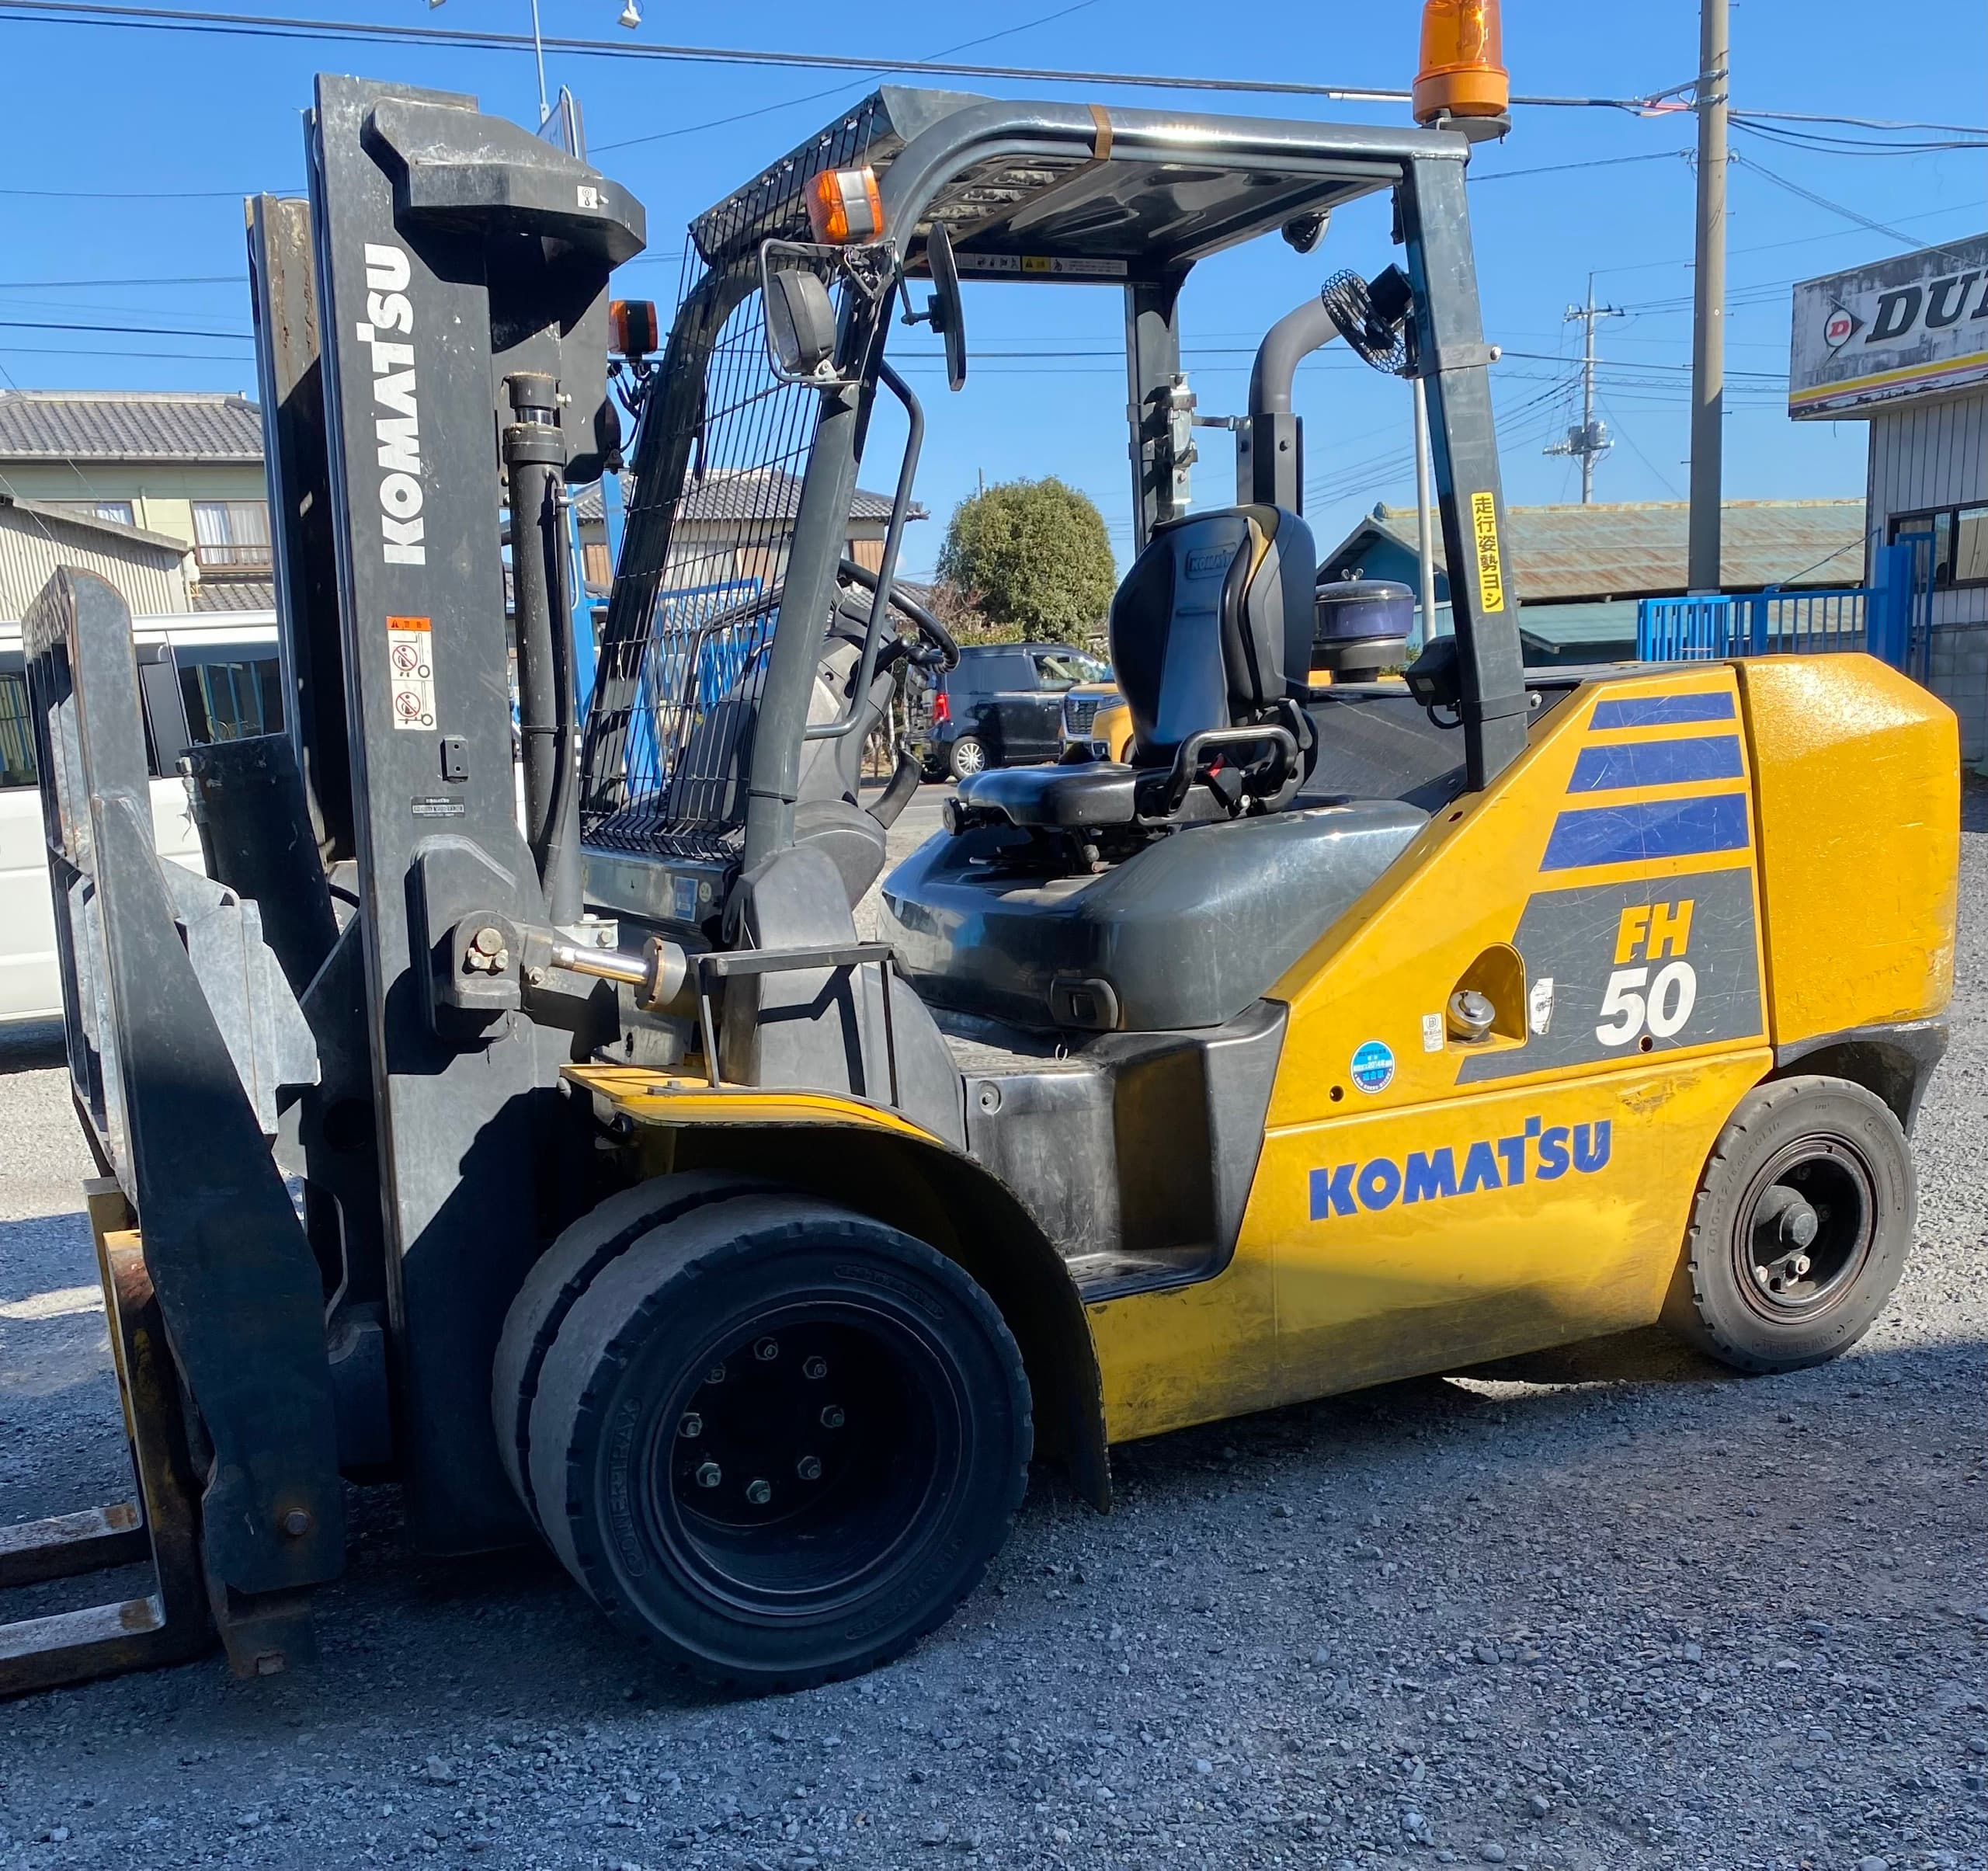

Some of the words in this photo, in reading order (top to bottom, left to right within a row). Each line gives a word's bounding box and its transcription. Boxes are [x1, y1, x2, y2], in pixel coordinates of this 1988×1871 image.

[356, 242, 426, 566] KOMATSU
[1474, 496, 1502, 609] 走行姿勢ヨシ
[1614, 899, 1695, 965] FH
[1596, 961, 1698, 1047] 50
[1309, 1115, 1611, 1221] KOMATSU
